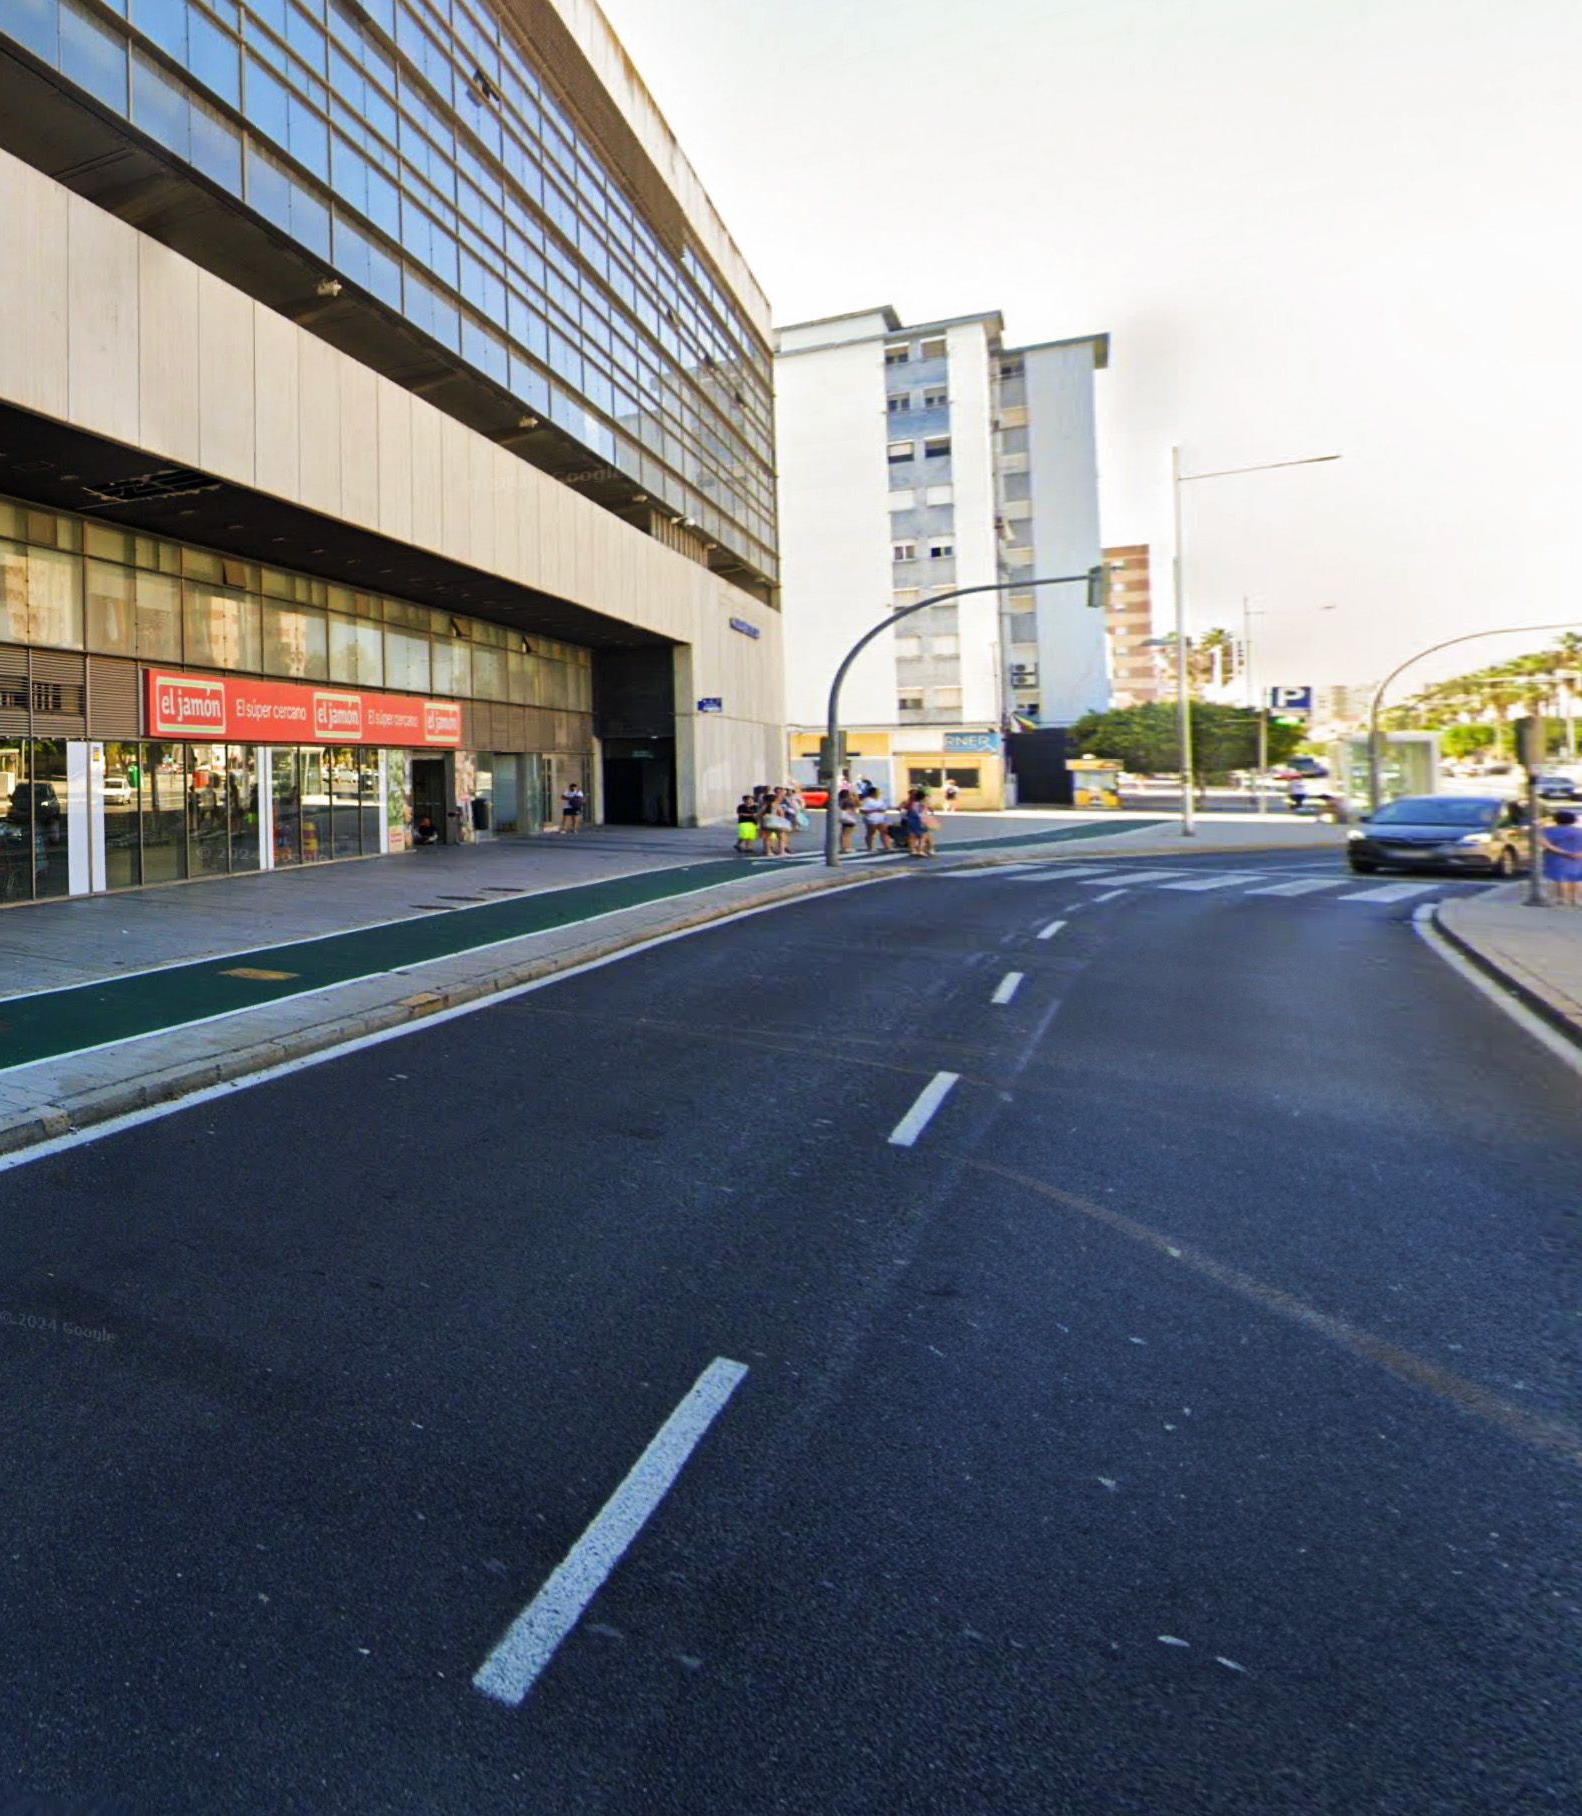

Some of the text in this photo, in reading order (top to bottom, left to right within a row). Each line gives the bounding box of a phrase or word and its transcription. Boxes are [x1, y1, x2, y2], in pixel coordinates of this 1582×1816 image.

[161, 687, 175, 716] el
[176, 687, 222, 722] jamón
[235, 698, 245, 717] El
[246, 698, 273, 721] súper
[273, 704, 307, 721] cercano
[318, 700, 328, 724] el
[328, 700, 359, 730] jamón
[1276, 687, 1306, 708] P
